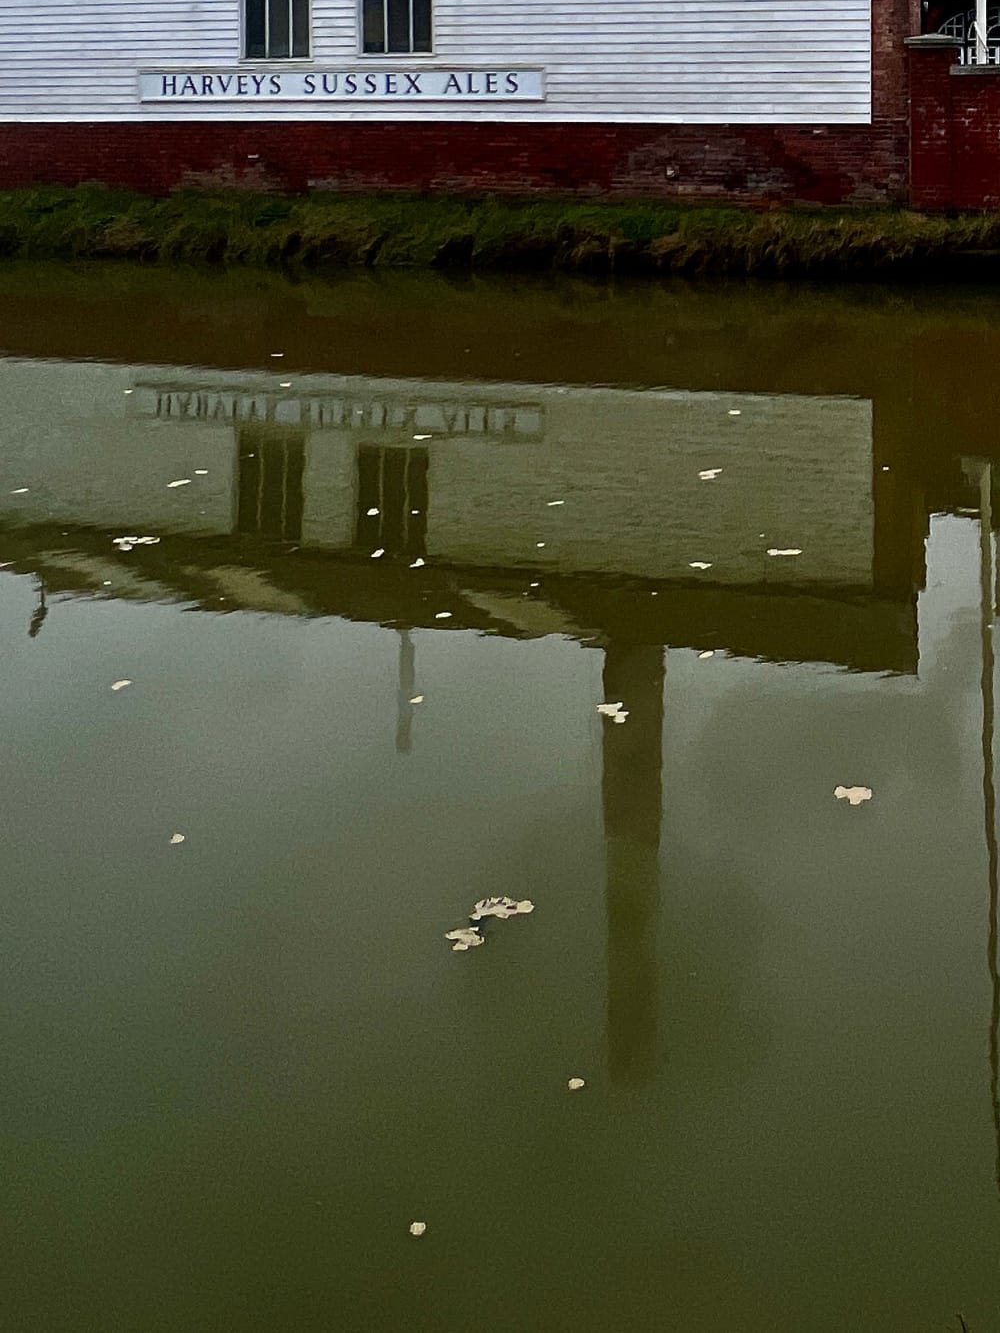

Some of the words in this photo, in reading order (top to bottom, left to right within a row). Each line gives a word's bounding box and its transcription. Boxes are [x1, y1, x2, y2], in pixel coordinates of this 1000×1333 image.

[161, 74, 282, 96] HARVEYS
[304, 73, 422, 95] SUSSEX
[443, 73, 520, 94] ALES
